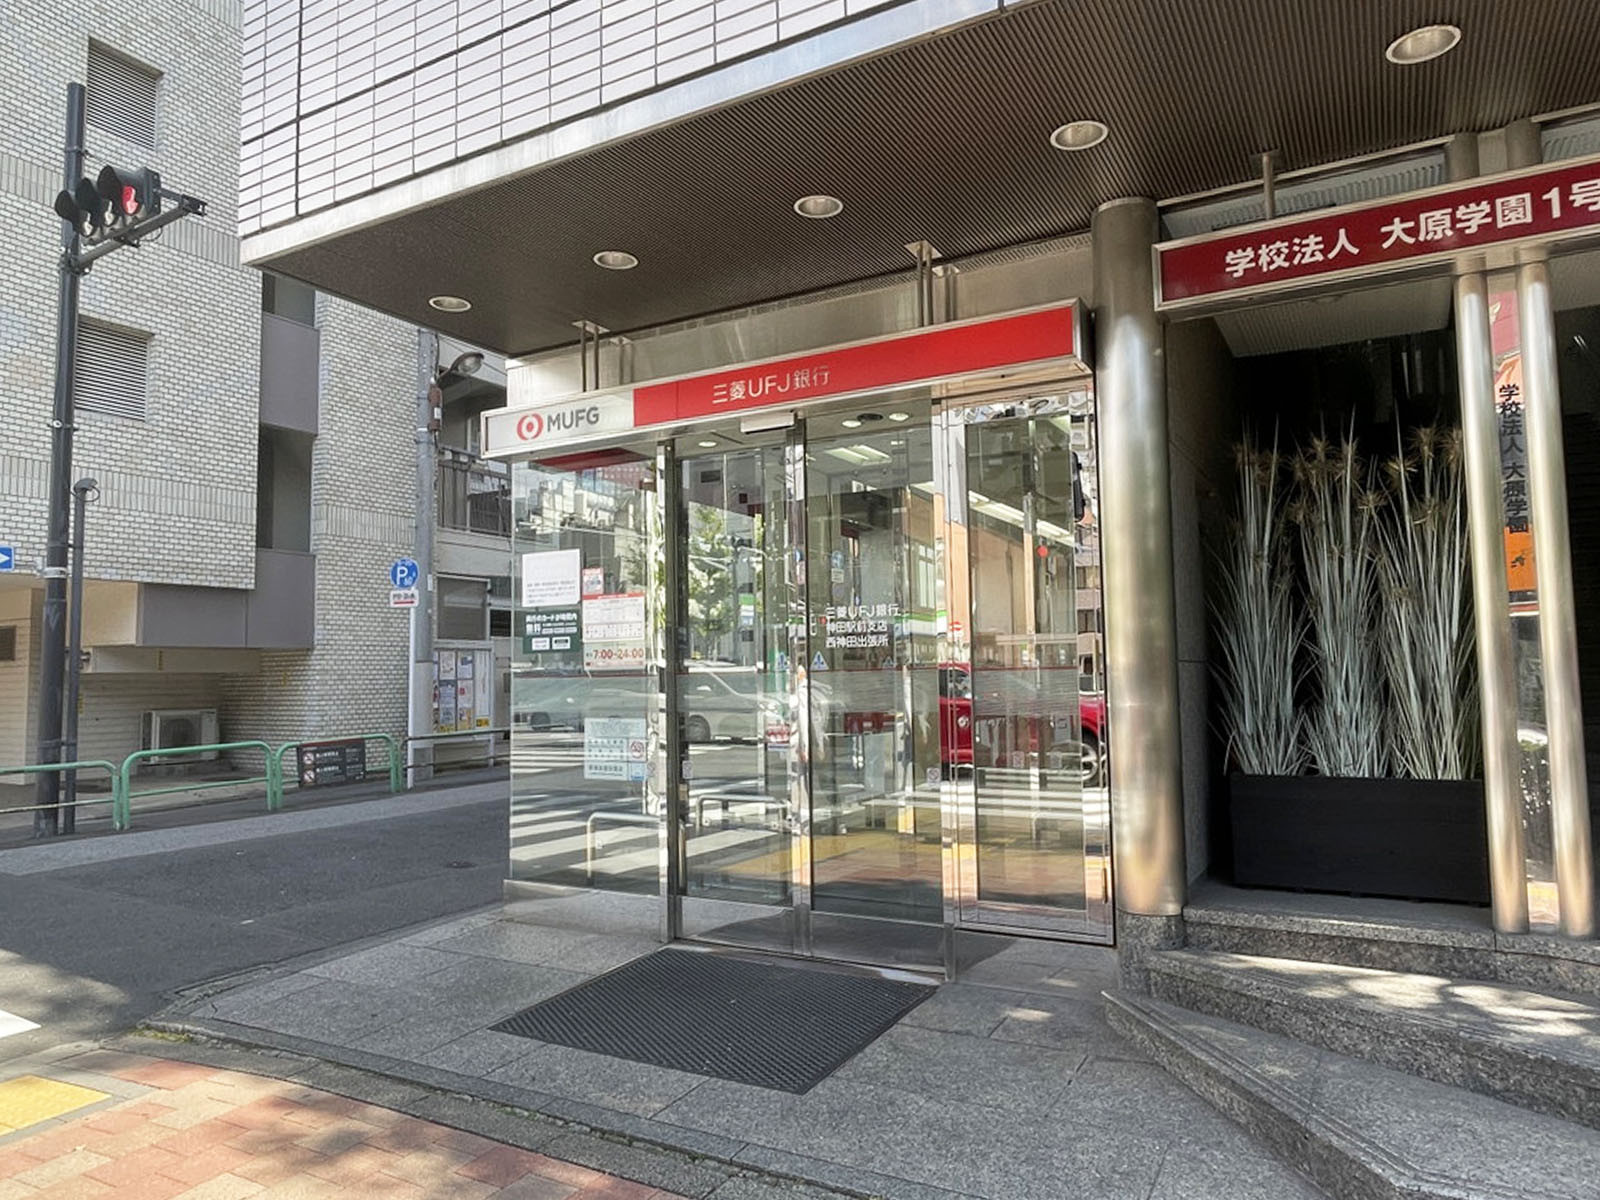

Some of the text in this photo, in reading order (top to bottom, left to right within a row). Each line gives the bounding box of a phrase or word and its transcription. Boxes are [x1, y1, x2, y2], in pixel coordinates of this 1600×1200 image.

[1225, 228, 1359, 278] 学校法人
[712, 365, 831, 405] 三菱UFJ銀行
[547, 406, 600, 433] MUFG
[396, 566, 409, 585] P
[826, 603, 901, 619] 三菱UFJ銀行
[825, 634, 889, 649] 西神田出張所
